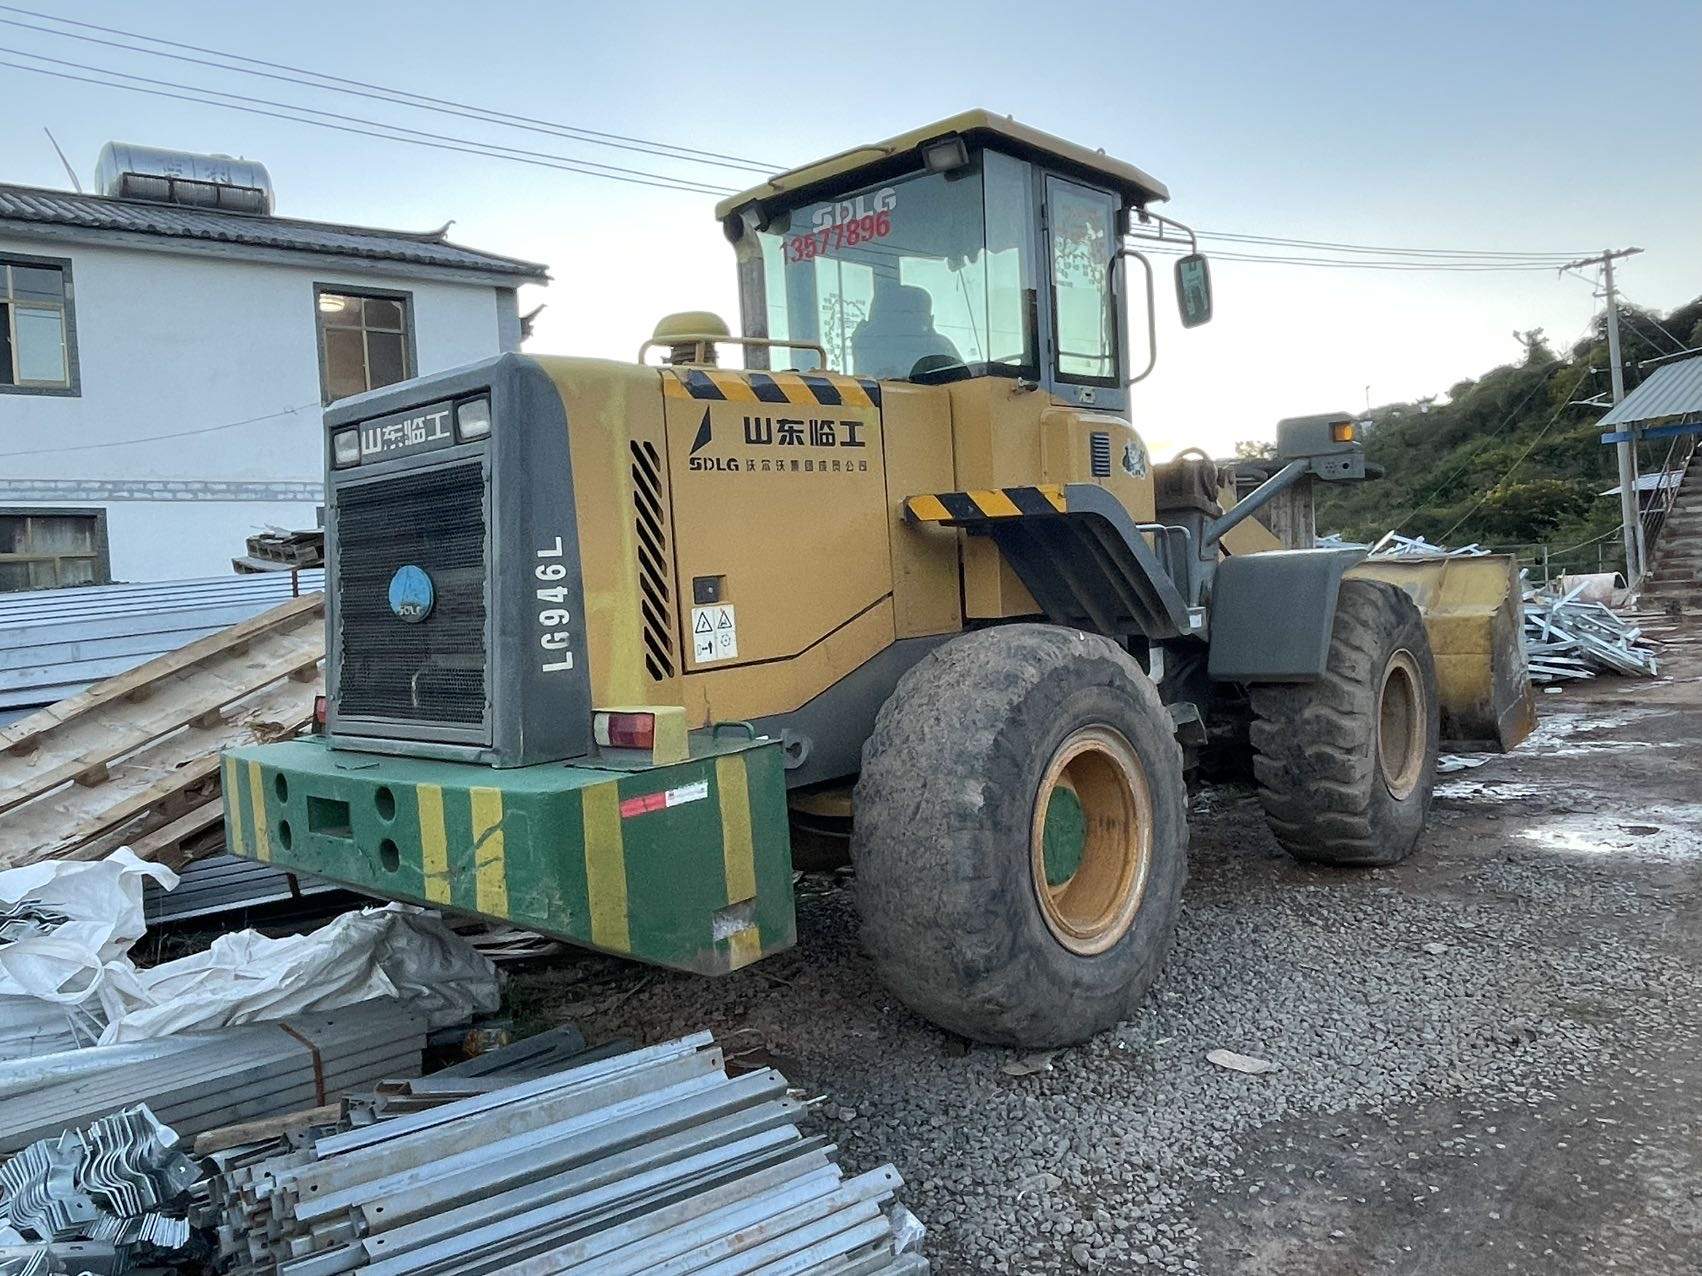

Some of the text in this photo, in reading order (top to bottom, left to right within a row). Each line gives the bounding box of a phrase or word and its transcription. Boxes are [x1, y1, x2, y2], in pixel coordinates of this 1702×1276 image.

[812, 187, 897, 234] SDLG
[361, 410, 450, 455] 山东临工
[743, 416, 866, 447] 山东临工
[689, 457, 739, 472] SDLG
[534, 536, 574, 672] LG946L
